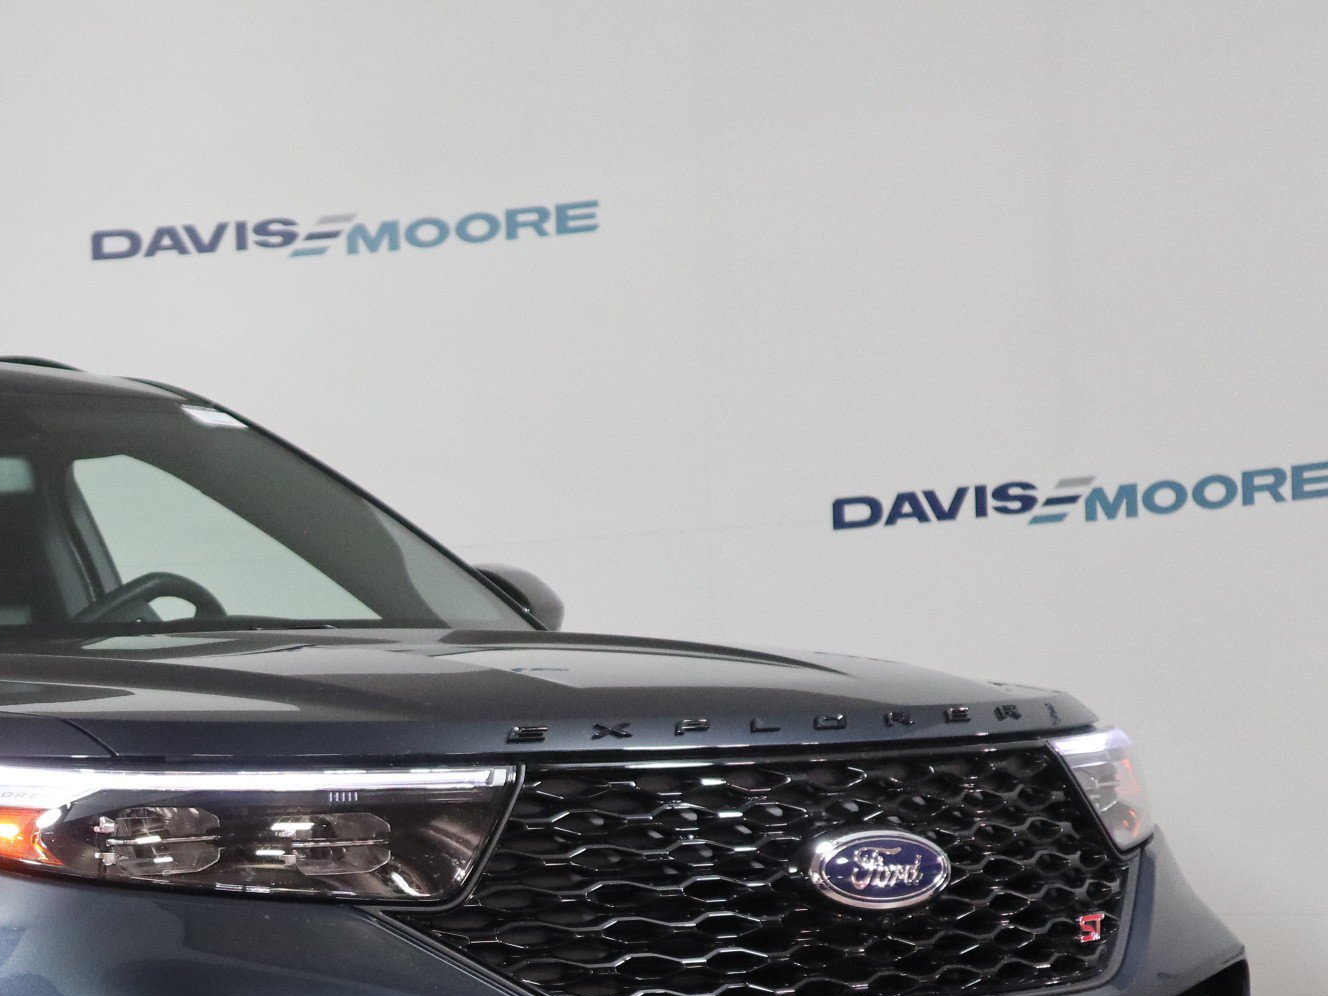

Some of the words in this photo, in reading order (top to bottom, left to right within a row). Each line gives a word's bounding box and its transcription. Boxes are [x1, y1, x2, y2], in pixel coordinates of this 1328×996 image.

[90, 216, 300, 260] DAVIS
[346, 199, 601, 256] MOORE
[831, 480, 1040, 531] DAVIS
[1083, 460, 1328, 523] MOORE
[506, 703, 1022, 744] EXPLORER
[850, 846, 924, 891] Ford
[1078, 913, 1105, 943] ST
